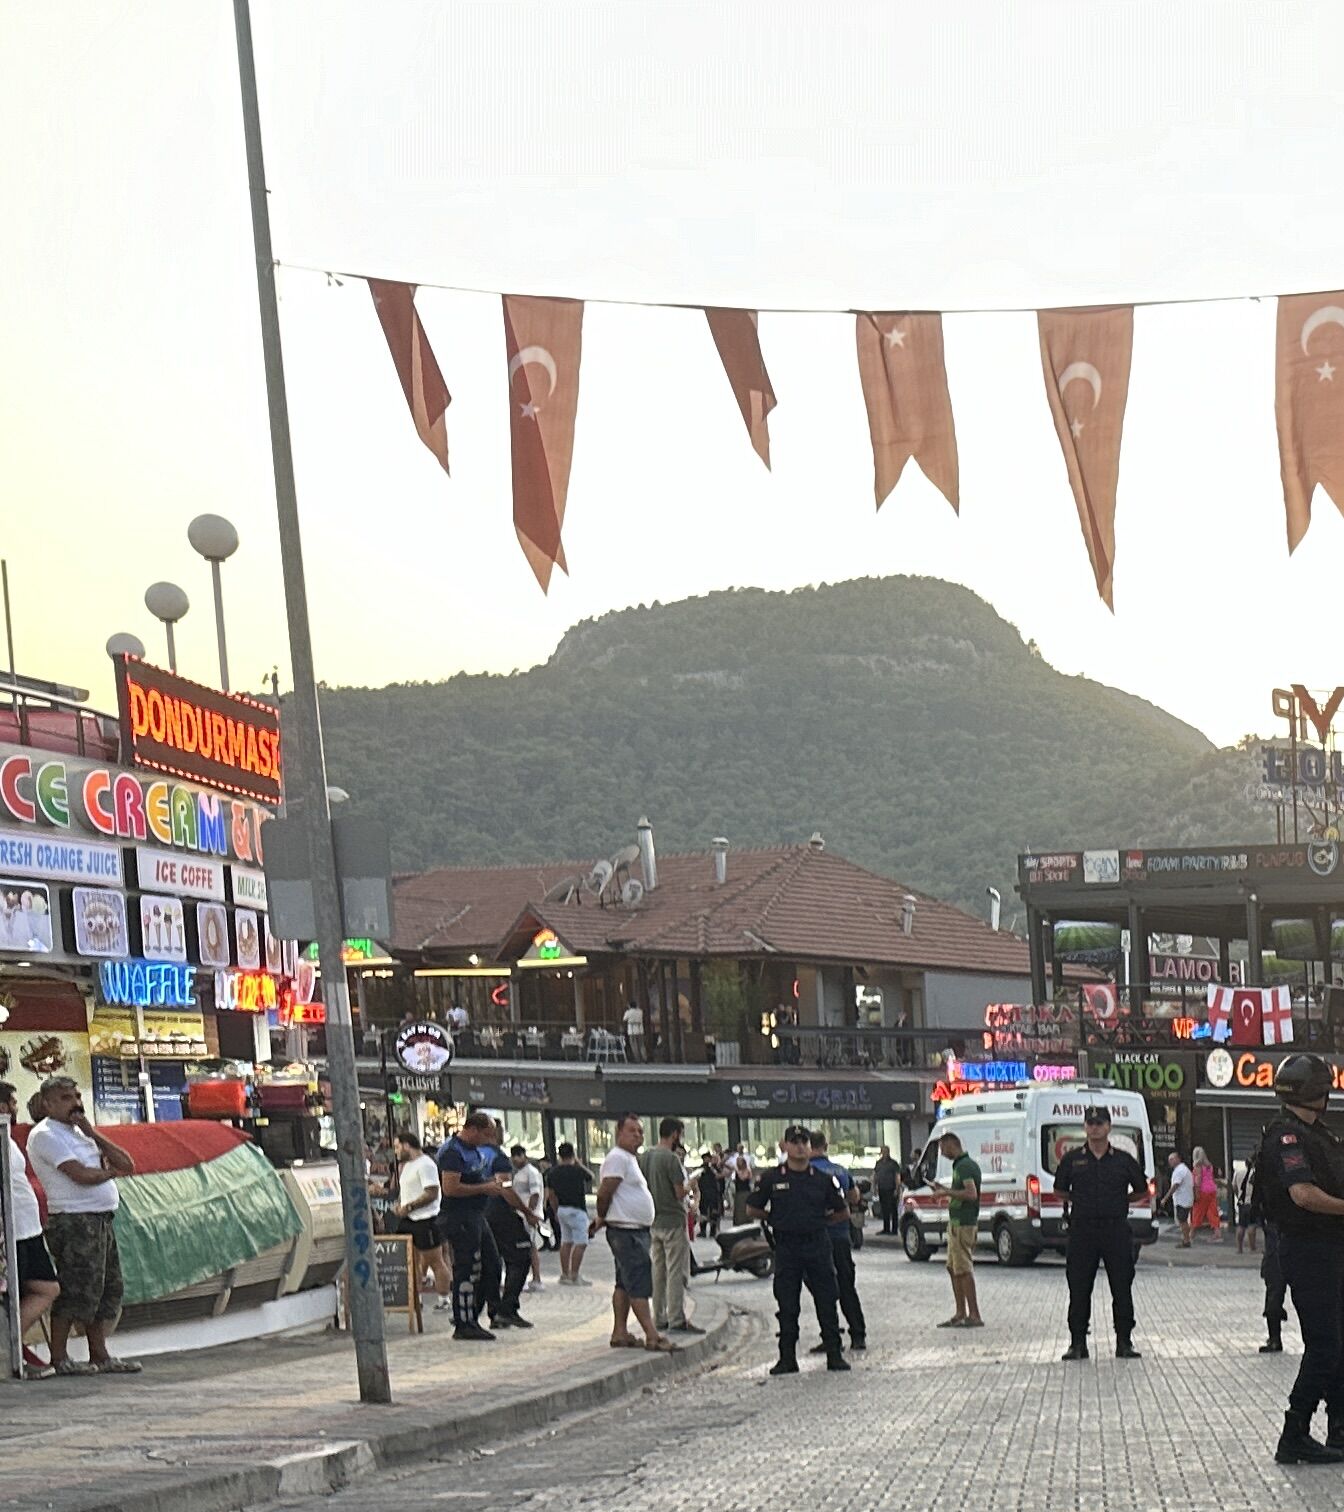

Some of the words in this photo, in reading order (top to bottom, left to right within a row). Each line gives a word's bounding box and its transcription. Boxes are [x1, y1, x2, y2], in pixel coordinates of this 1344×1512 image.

[84, 769, 228, 857] CREAM
[231, 800, 253, 862] &
[37, 845, 84, 875] ORANGE
[87, 852, 118, 876] JUICE
[155, 860, 177, 883] ICE
[181, 866, 214, 890] COFFE
[1147, 857, 1179, 871] FOAM
[104, 960, 197, 1005] WAFFLE
[1115, 1053, 1142, 1065] BLACK
[1144, 1053, 1160, 1066] CAT
[1094, 1062, 1185, 1090] TATTOO
[1052, 1103, 1130, 1118] AMBNS
